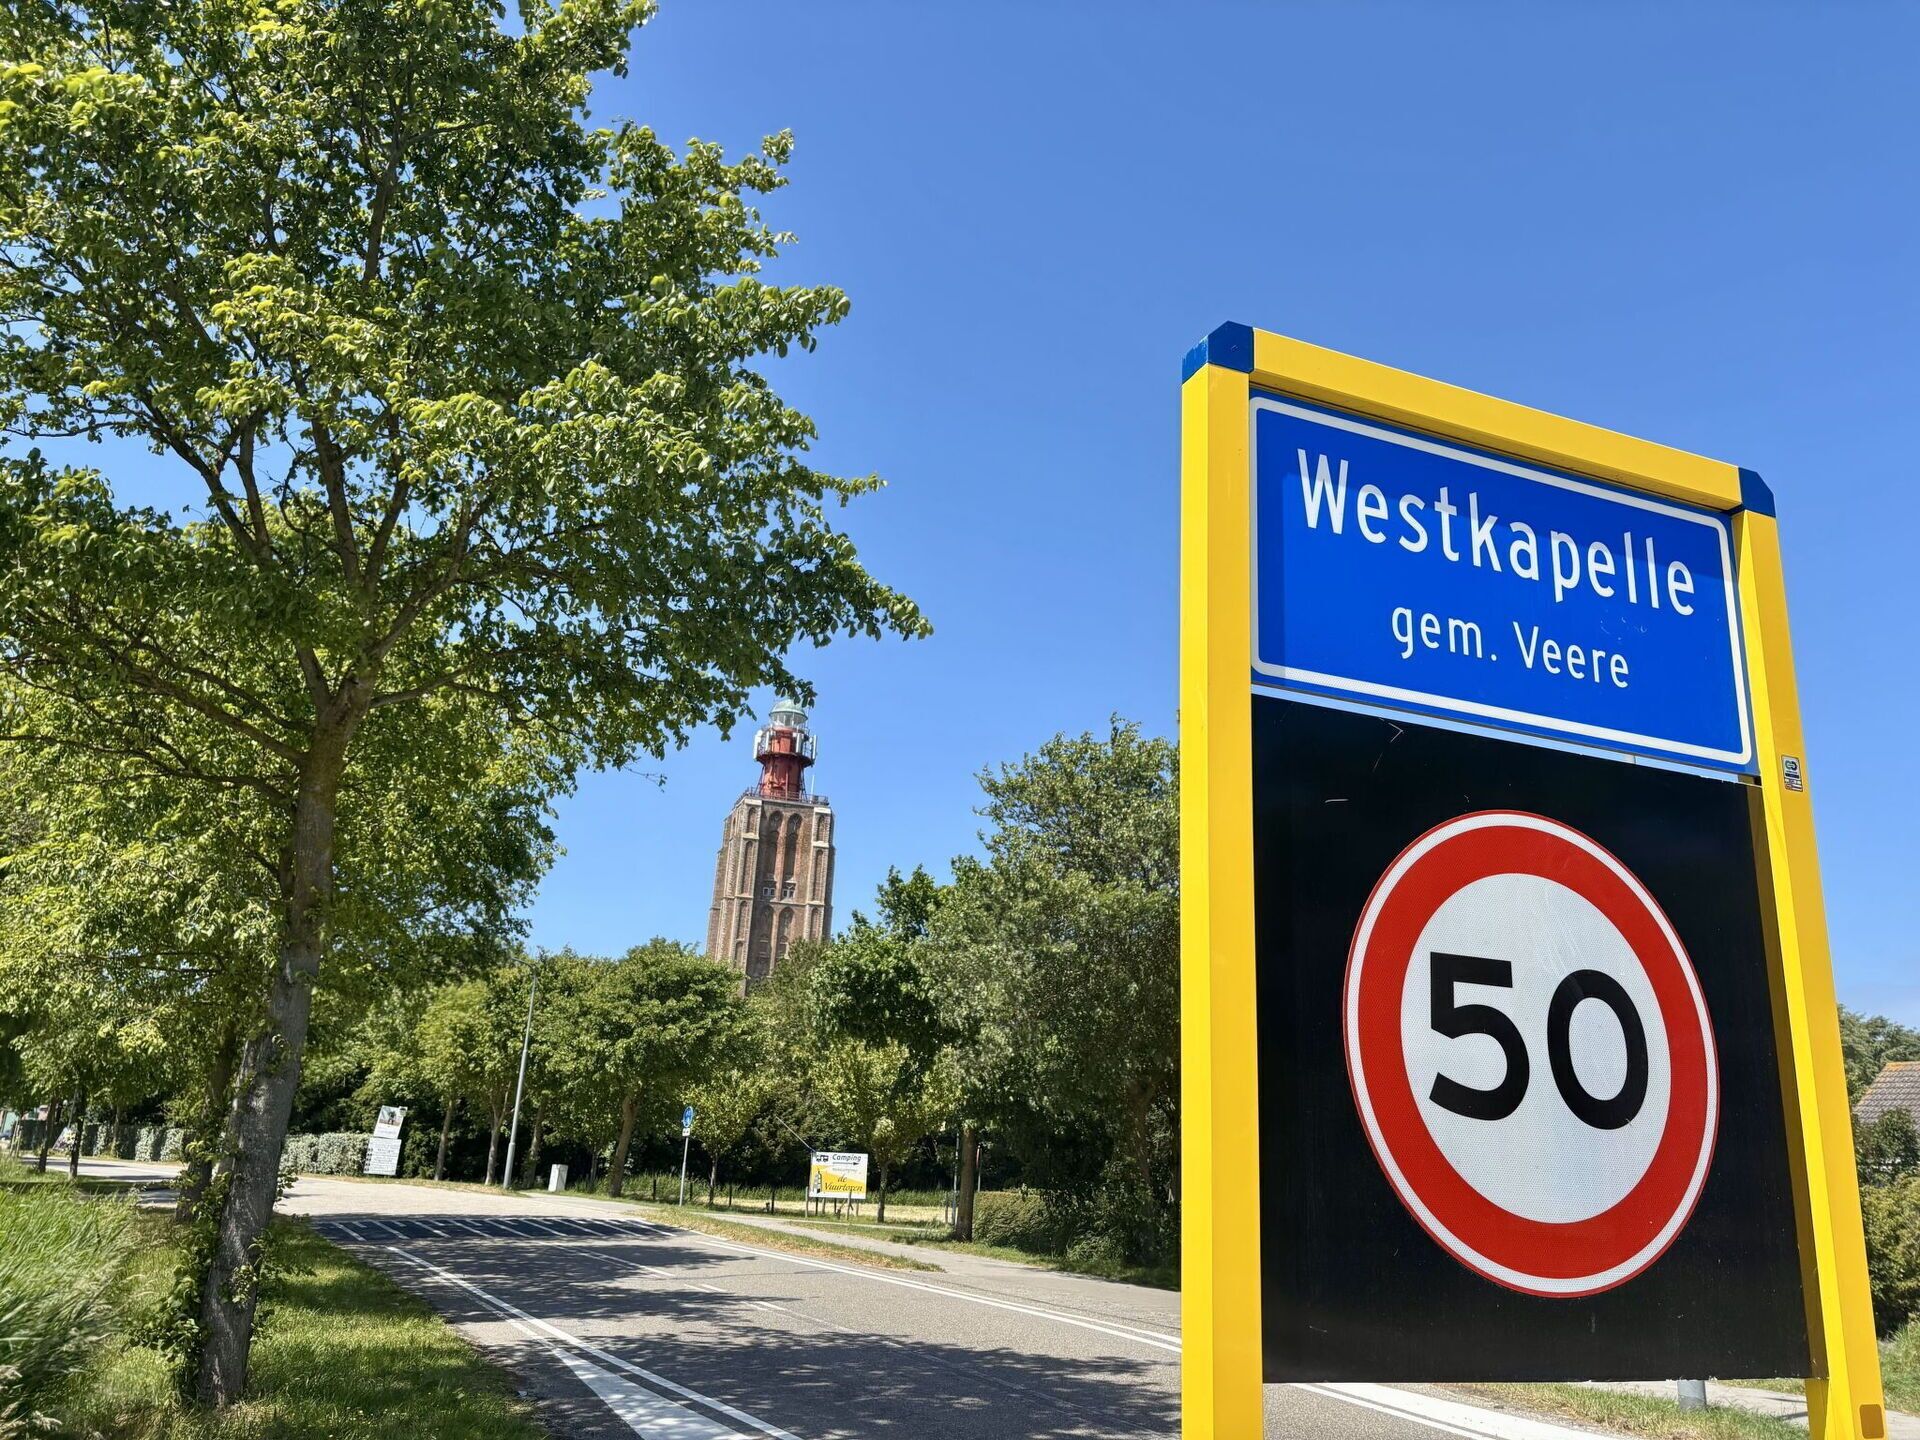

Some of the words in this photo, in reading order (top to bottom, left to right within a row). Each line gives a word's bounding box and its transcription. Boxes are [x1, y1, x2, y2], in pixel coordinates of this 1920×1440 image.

[1297, 448, 1695, 616] Westkapelle
[1391, 606, 1498, 661] gem.
[1512, 621, 1630, 688] Veere
[1428, 951, 1649, 1131] 50
[832, 1154, 862, 1162] Camping
